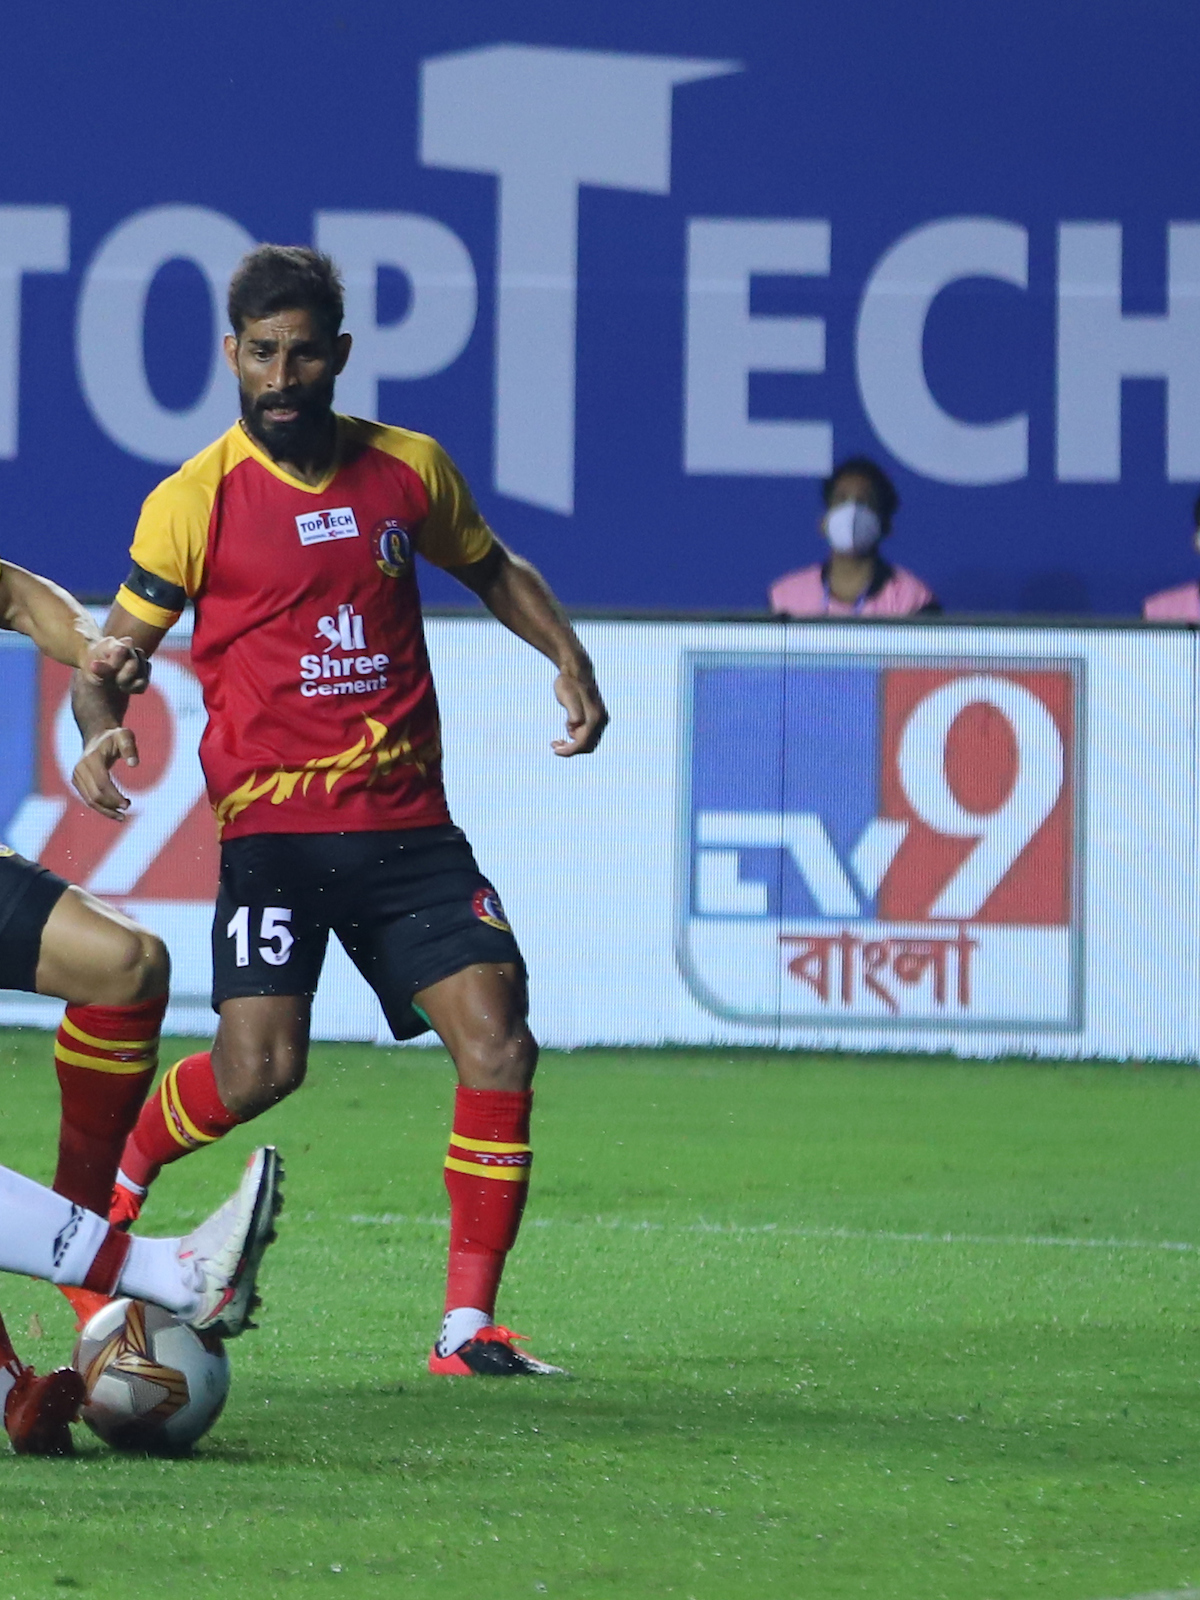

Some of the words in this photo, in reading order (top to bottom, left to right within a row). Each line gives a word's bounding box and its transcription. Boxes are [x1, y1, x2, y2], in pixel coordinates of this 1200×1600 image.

[300, 512, 353, 532] TOPTECH
[300, 653, 390, 680] Shree
[300, 674, 388, 697] Cement
[697, 675, 1064, 918] TV9
[227, 906, 294, 967] 15
[779, 921, 979, 1013] বাংলা
